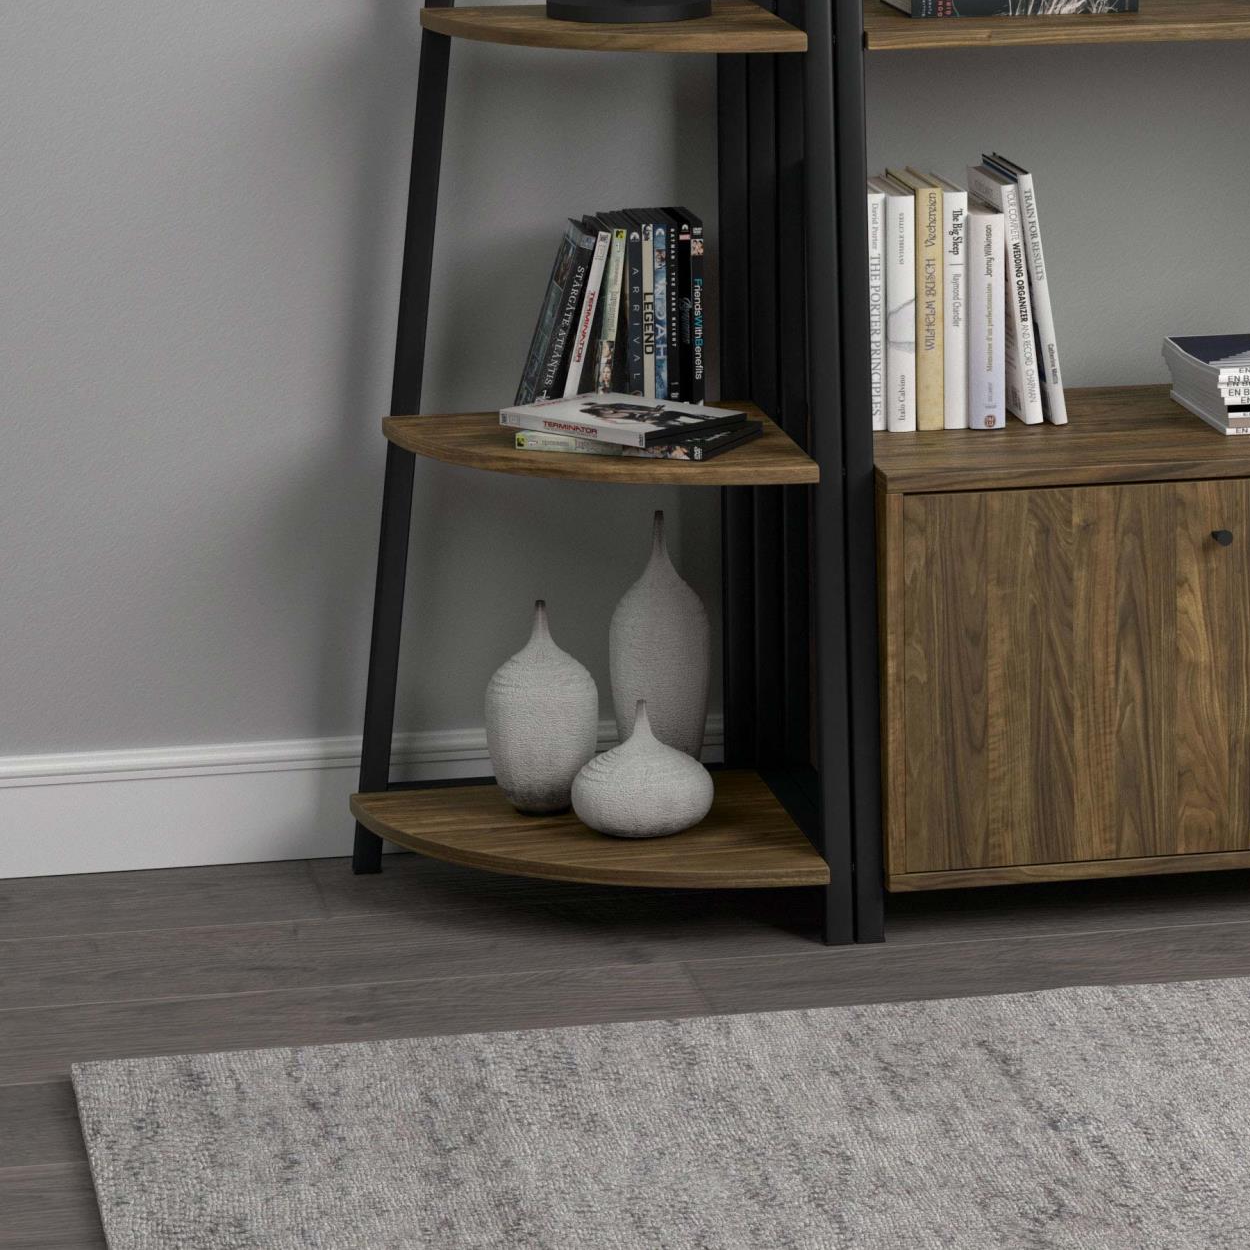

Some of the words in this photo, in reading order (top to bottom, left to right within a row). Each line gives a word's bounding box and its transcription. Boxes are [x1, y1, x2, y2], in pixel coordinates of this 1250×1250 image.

[1006, 189, 1018, 207] YOUR
[1023, 189, 1036, 218] TRAIN
[949, 223, 963, 235] Big
[953, 209, 963, 222] The
[1008, 208, 1022, 241] COMPLETE
[1027, 220, 1040, 240] FOR
[948, 236, 962, 255] Sleep
[984, 225, 992, 256] Wilkinson
[870, 254, 881, 281] THE
[984, 257, 995, 277] Jonny
[1012, 242, 1025, 277] WEDDING
[1029, 242, 1045, 281] RESULTS
[925, 259, 936, 297] BUSCH
[951, 273, 961, 300] Raymond
[562, 265, 585, 325] STARGATE
[1015, 280, 1028, 322] ORGANIZER
[631, 268, 640, 379] ARRIVAL
[643, 292, 653, 355] LEGEND
[655, 280, 666, 359] NOAH
[870, 285, 881, 336] PORTER
[953, 302, 961, 327] Chandler
[574, 290, 596, 363] TERMINATOR
[925, 301, 937, 351] WILHELM
[1019, 324, 1030, 339] AND
[544, 326, 566, 386] ATLANTIS
[1022, 340, 1034, 365] RECORD
[1046, 343, 1056, 368] Catherine
[871, 340, 882, 416] PRINCIPLES
[898, 375, 906, 402] Calvino
[1025, 369, 1037, 404] CHAPMAN
[898, 404, 906, 420] Italo
[542, 420, 598, 435] TERMINATOR
